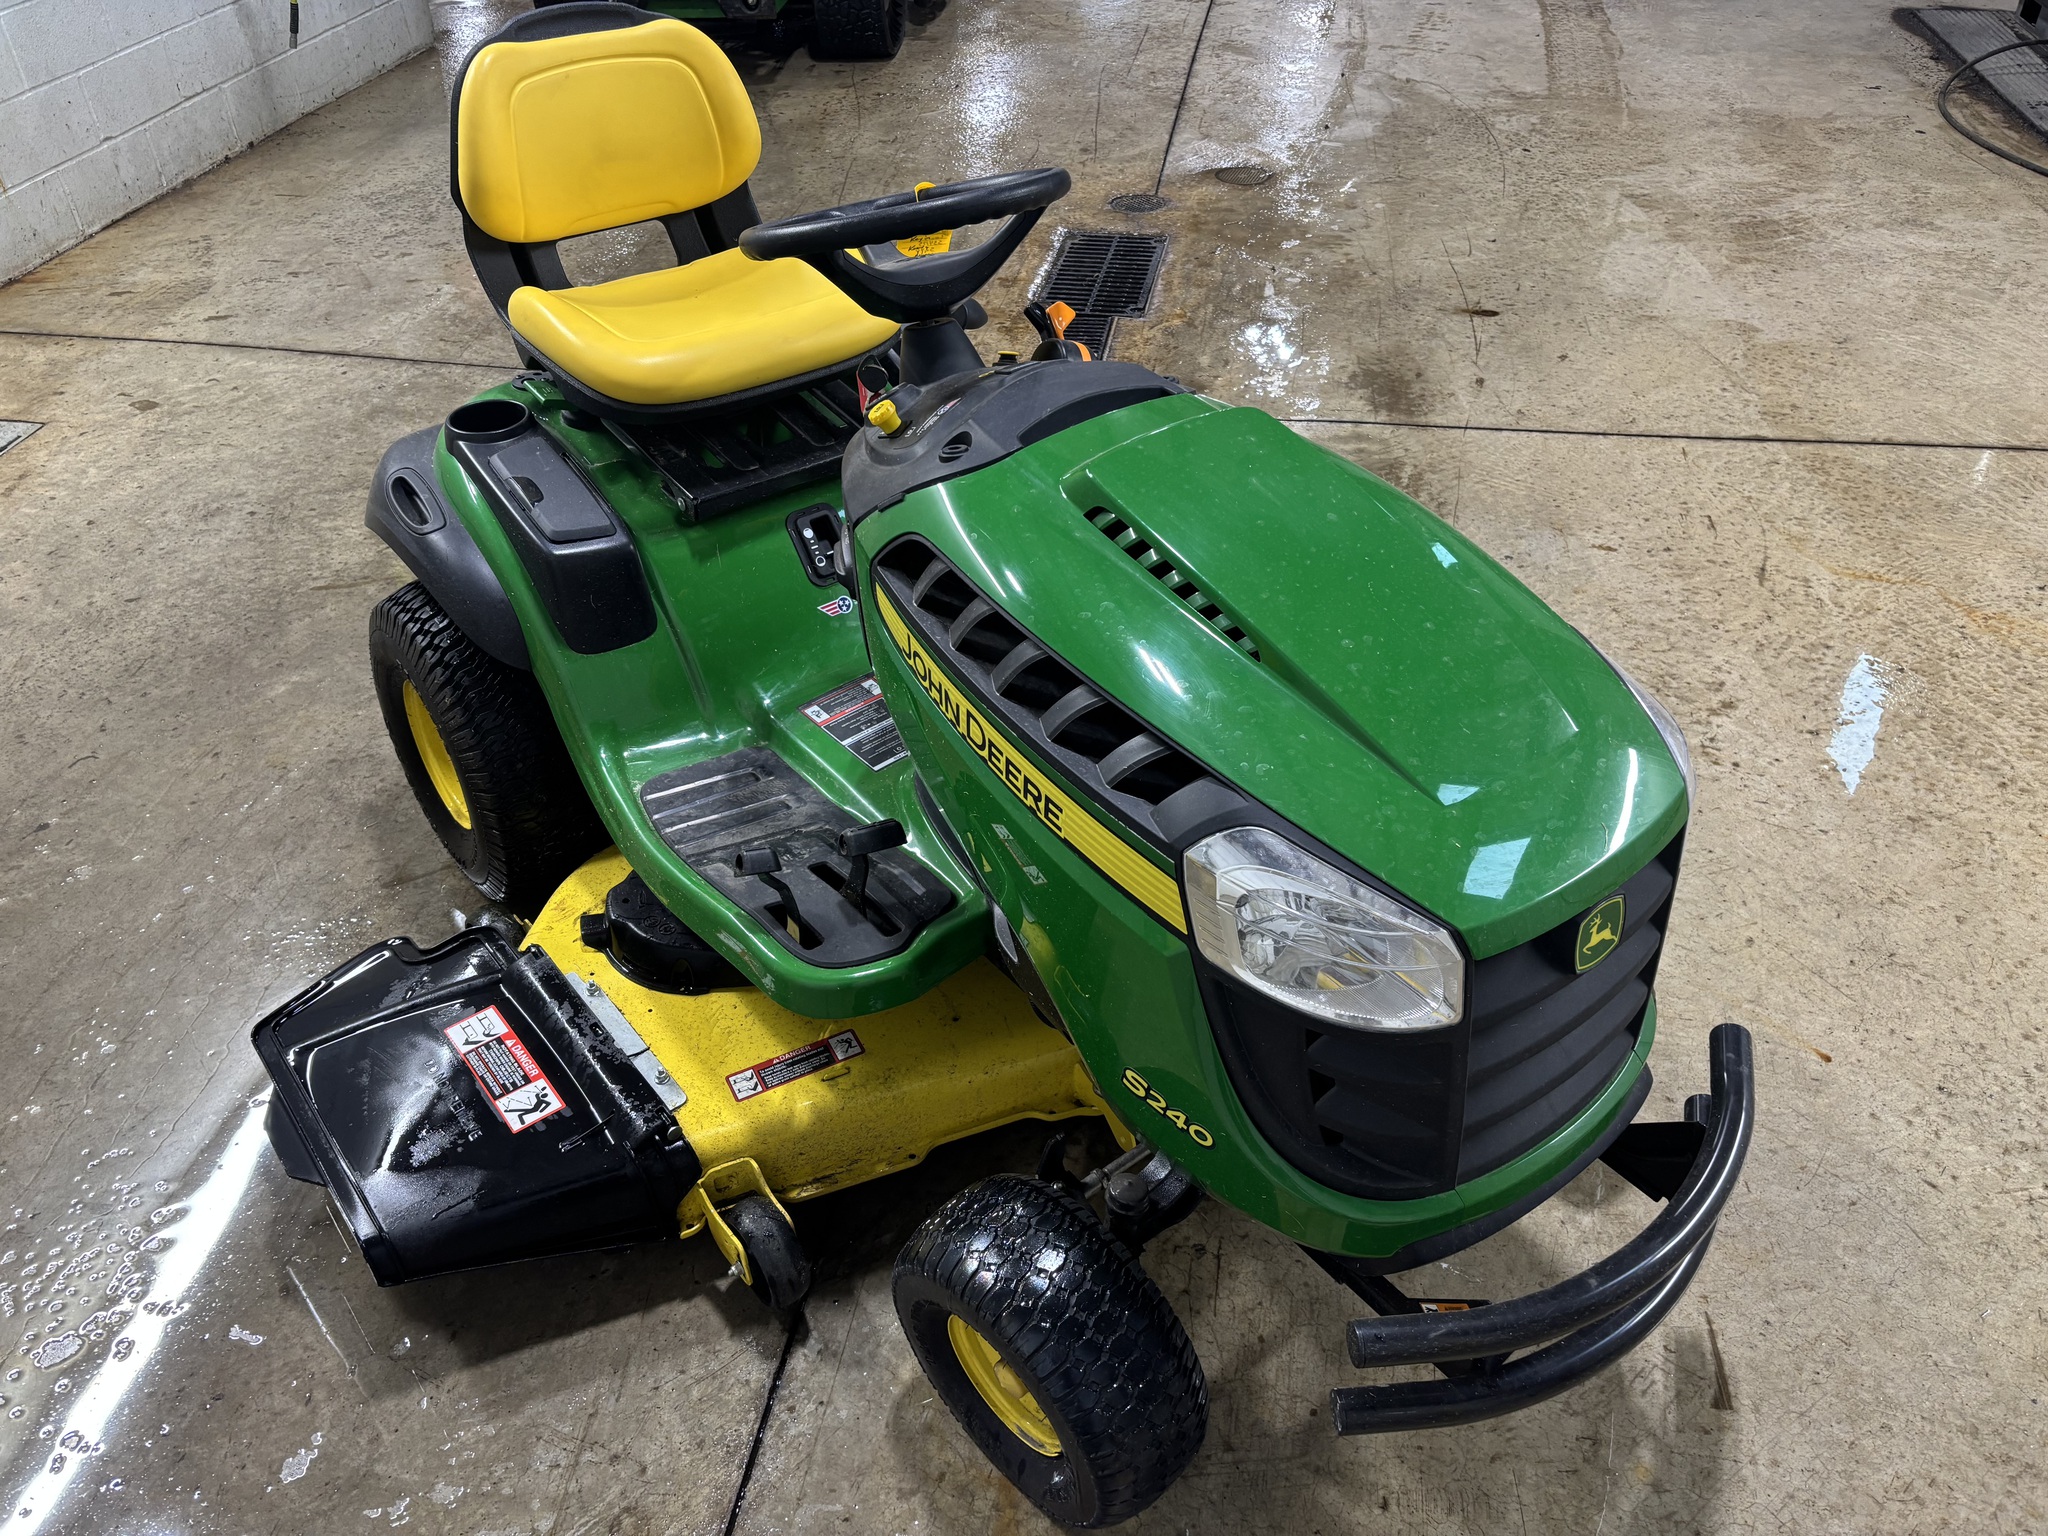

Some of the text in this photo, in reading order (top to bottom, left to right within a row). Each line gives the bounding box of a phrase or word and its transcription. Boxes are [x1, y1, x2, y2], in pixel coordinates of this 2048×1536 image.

[902, 633, 1064, 831] JOHN DEERE
[512, 1046, 540, 1077] DANGER
[780, 1045, 812, 1062] DANGER
[1122, 1069, 1214, 1147] S240
